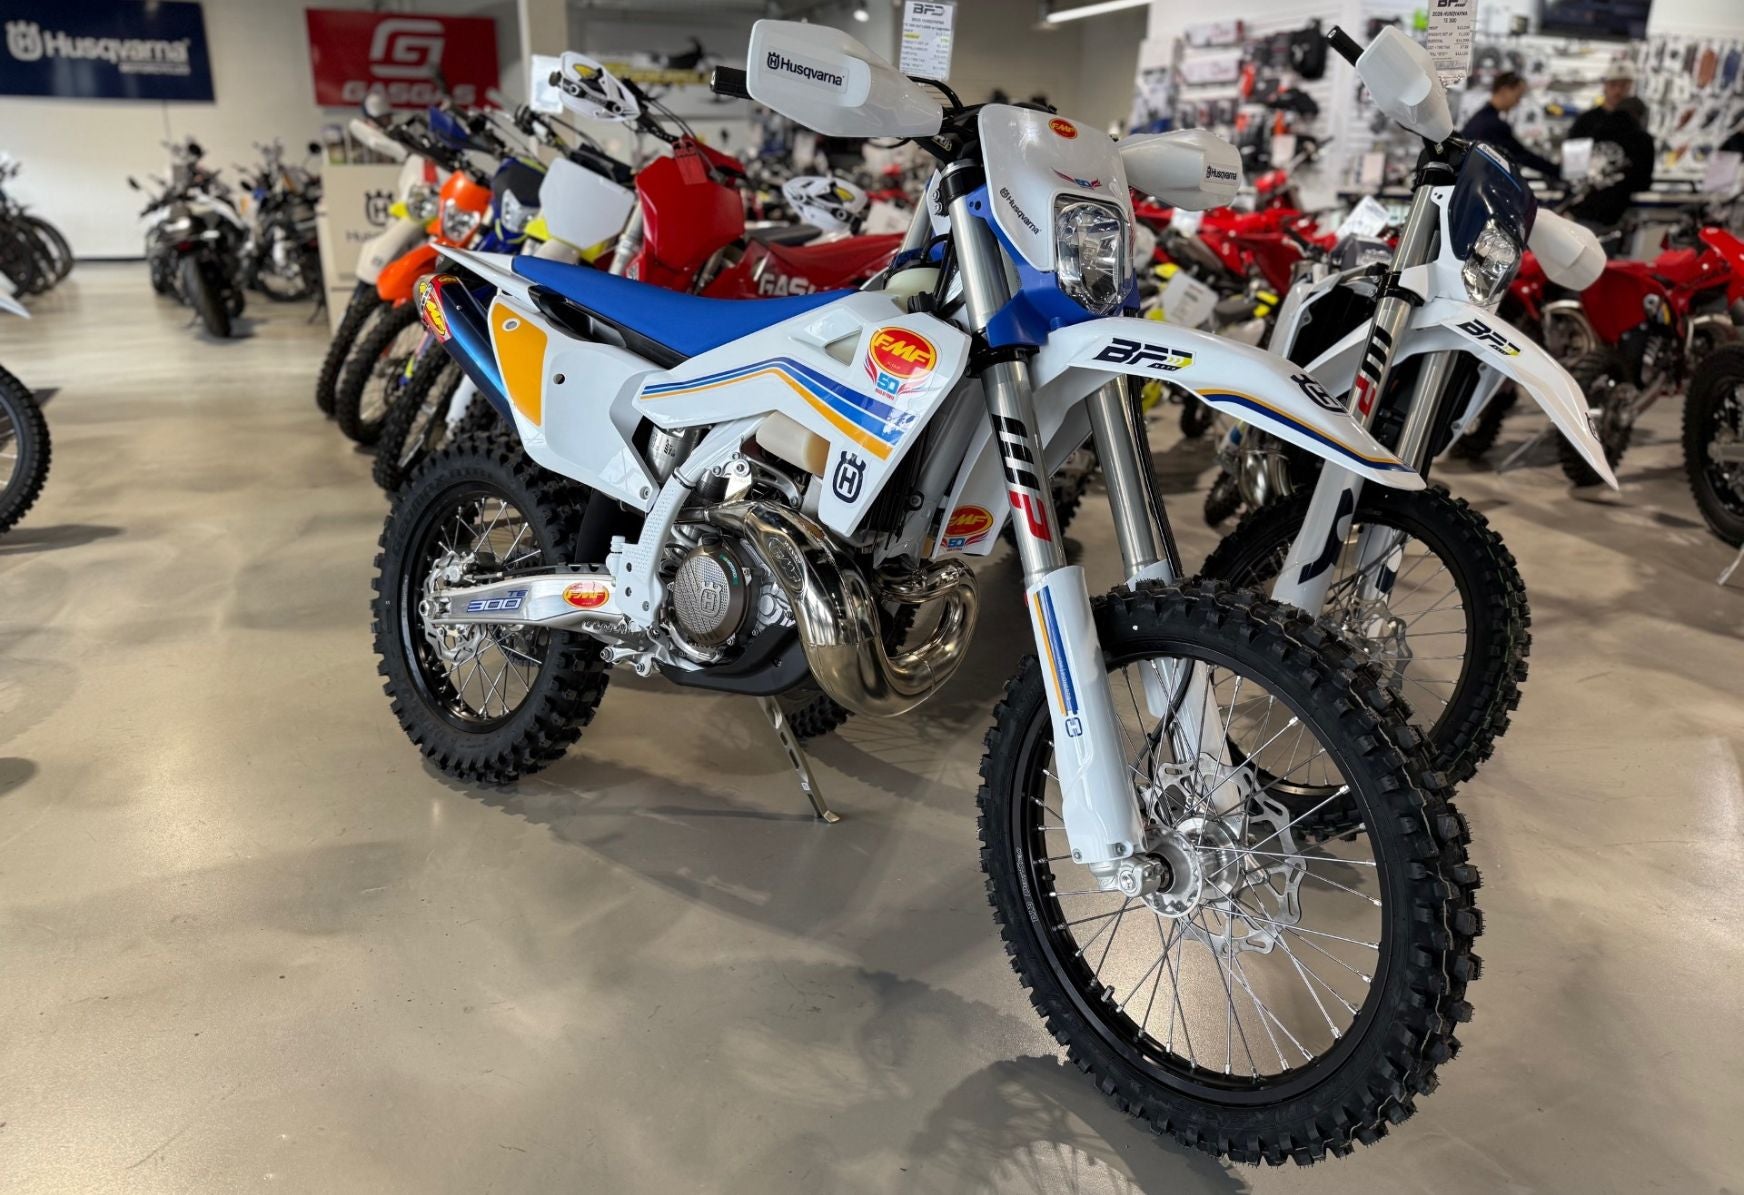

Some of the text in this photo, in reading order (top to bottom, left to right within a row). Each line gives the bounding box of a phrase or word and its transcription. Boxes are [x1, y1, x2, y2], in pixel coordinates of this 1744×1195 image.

[43, 31, 188, 64] Husqvarna
[780, 57, 843, 87] Husqvarna
[1210, 168, 1237, 181] Husqvarna
[1008, 195, 1040, 235] Husqvarna
[874, 333, 932, 363] FMF
[467, 597, 522, 613] 300
